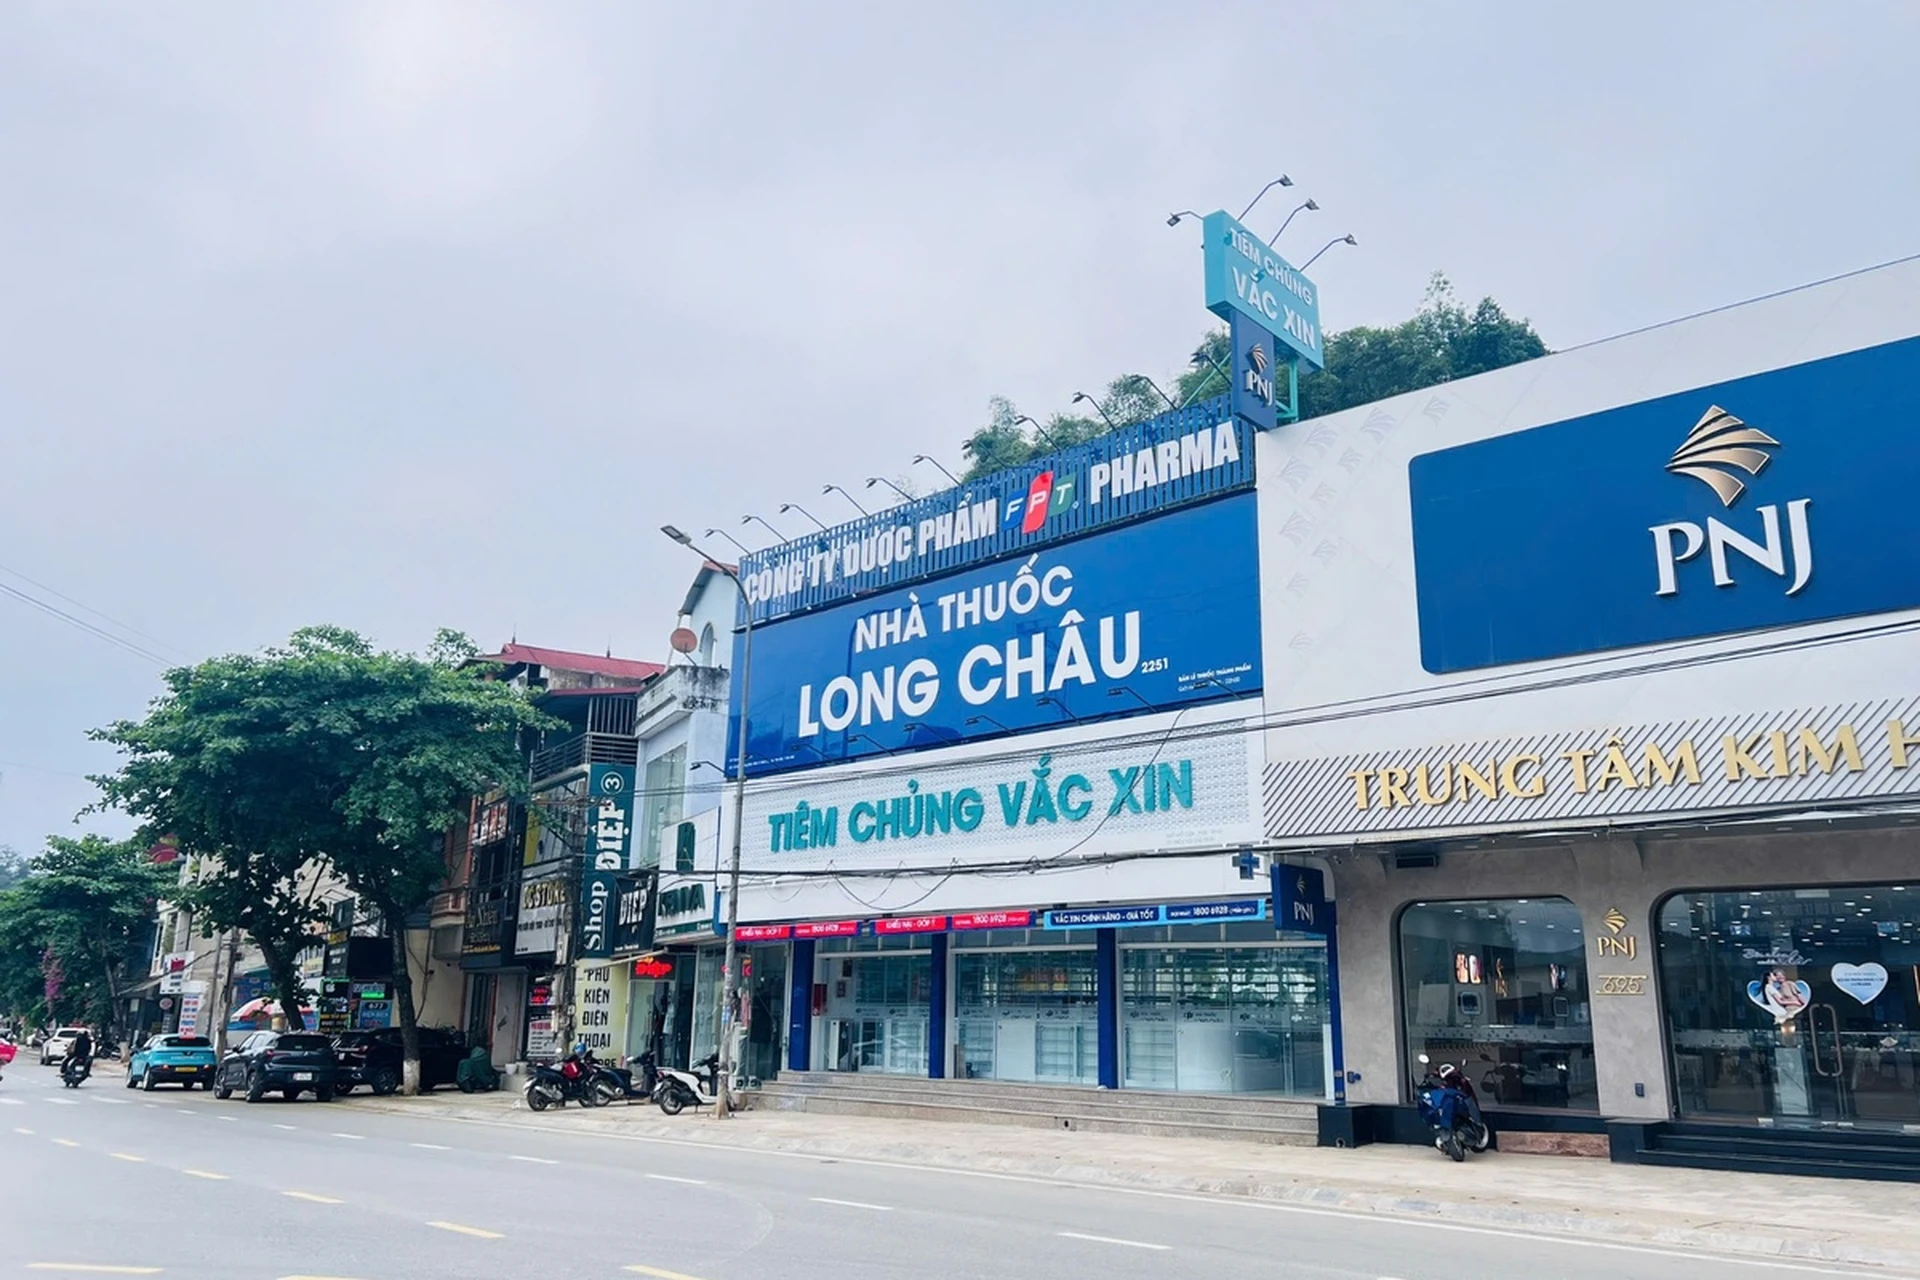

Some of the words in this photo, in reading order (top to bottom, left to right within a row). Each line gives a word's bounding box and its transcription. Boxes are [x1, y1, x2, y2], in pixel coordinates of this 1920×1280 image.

[1230, 227, 1261, 265] TIÊM
[1263, 256, 1313, 305] CHỦNG
[1283, 303, 1316, 350] XIN
[1245, 369, 1274, 406] PNJ
[744, 562, 804, 605] CÔNG
[810, 548, 839, 587] TY
[918, 493, 998, 556] PHẨM
[1003, 480, 1074, 526] FPT
[1091, 421, 1240, 505] PHARMA
[1647, 498, 1812, 596] PNJ
[856, 591, 928, 653] NHÀ
[938, 553, 1073, 632] THUỐC
[799, 658, 940, 738] LONG
[958, 609, 1140, 705] CHÂU
[1141, 658, 1169, 674] 2251
[1346, 753, 1546, 812] TRUNG
[1561, 736, 1701, 794] TÂM
[1722, 724, 1865, 782] KIM
[768, 800, 838, 853] TIÊM
[848, 780, 985, 843] CHỦNG
[999, 753, 1092, 827] VẮC
[1107, 759, 1193, 815] XIN
[584, 881, 608, 950] Shop
[1294, 901, 1315, 926] PNJ
[1597, 936, 1636, 960] PNJ
[582, 1011, 608, 1027] ĐIỆN
[584, 988, 610, 1004] KIỆN
[578, 1033, 611, 1049] THOẠI
